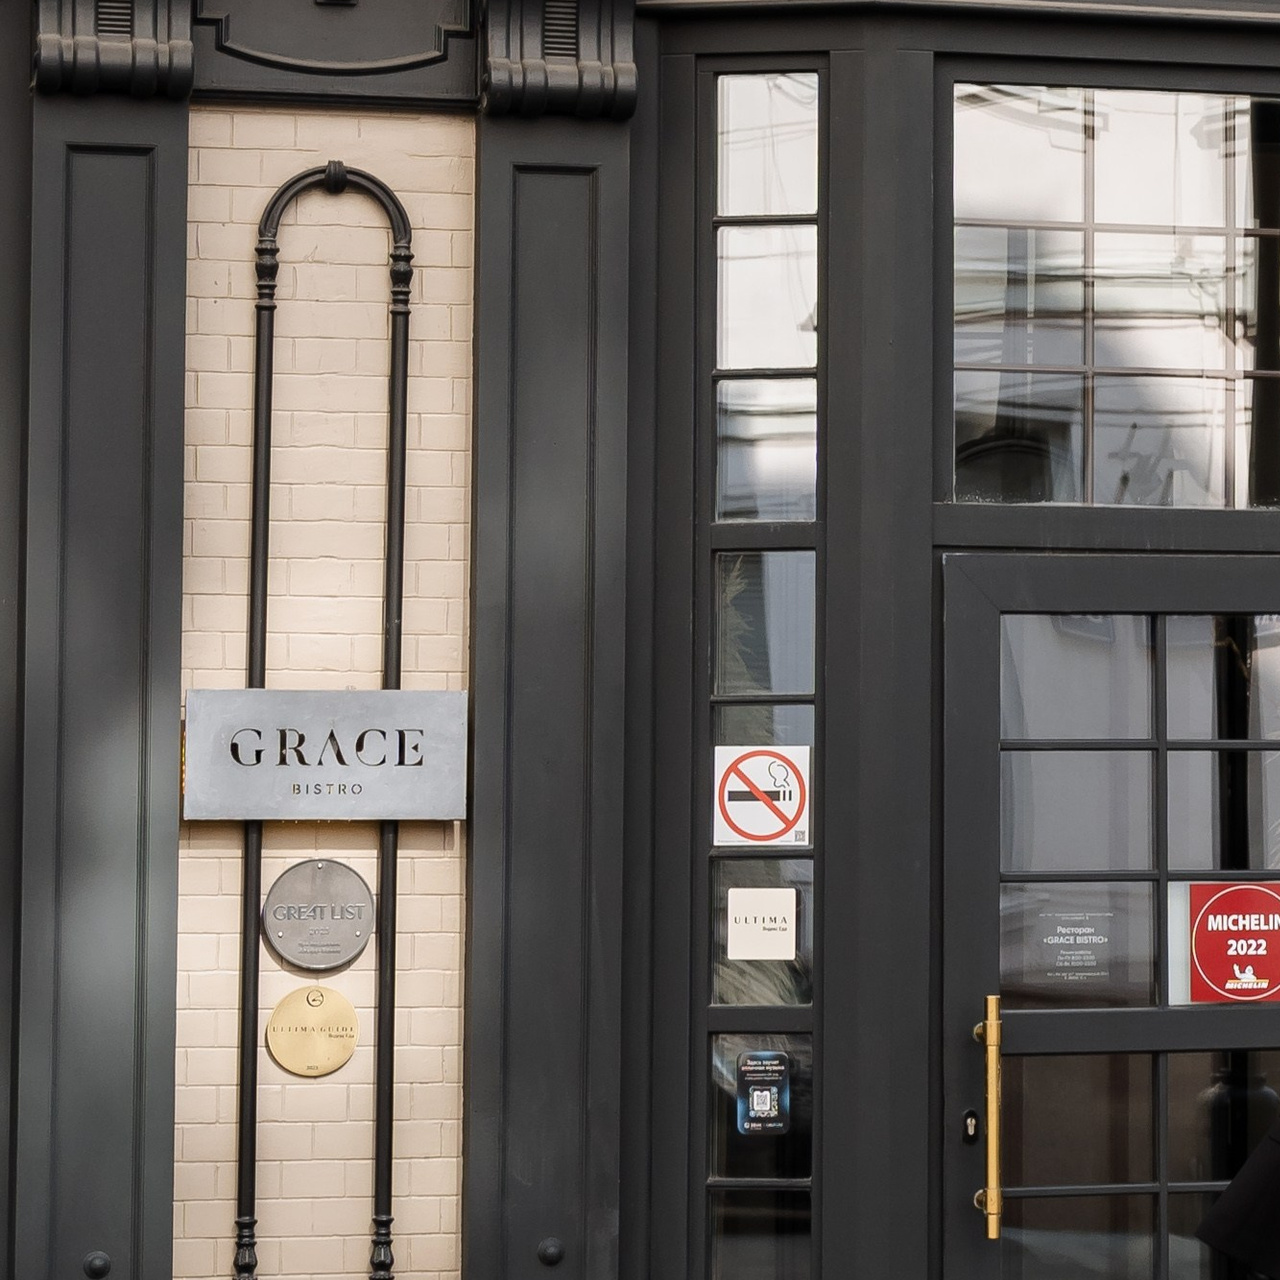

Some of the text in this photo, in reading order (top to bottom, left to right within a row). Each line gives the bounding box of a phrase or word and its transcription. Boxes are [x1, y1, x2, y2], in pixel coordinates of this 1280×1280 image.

[230, 728, 424, 767] GRACE
[292, 783, 363, 795] BISTRO
[273, 903, 366, 920] GREAT LIST
[734, 916, 787, 924] ULTIMA
[1057, 926, 1095, 935] Ресторан
[1227, 939, 1267, 955] 2022
[1225, 981, 1268, 989] MICHELIN
